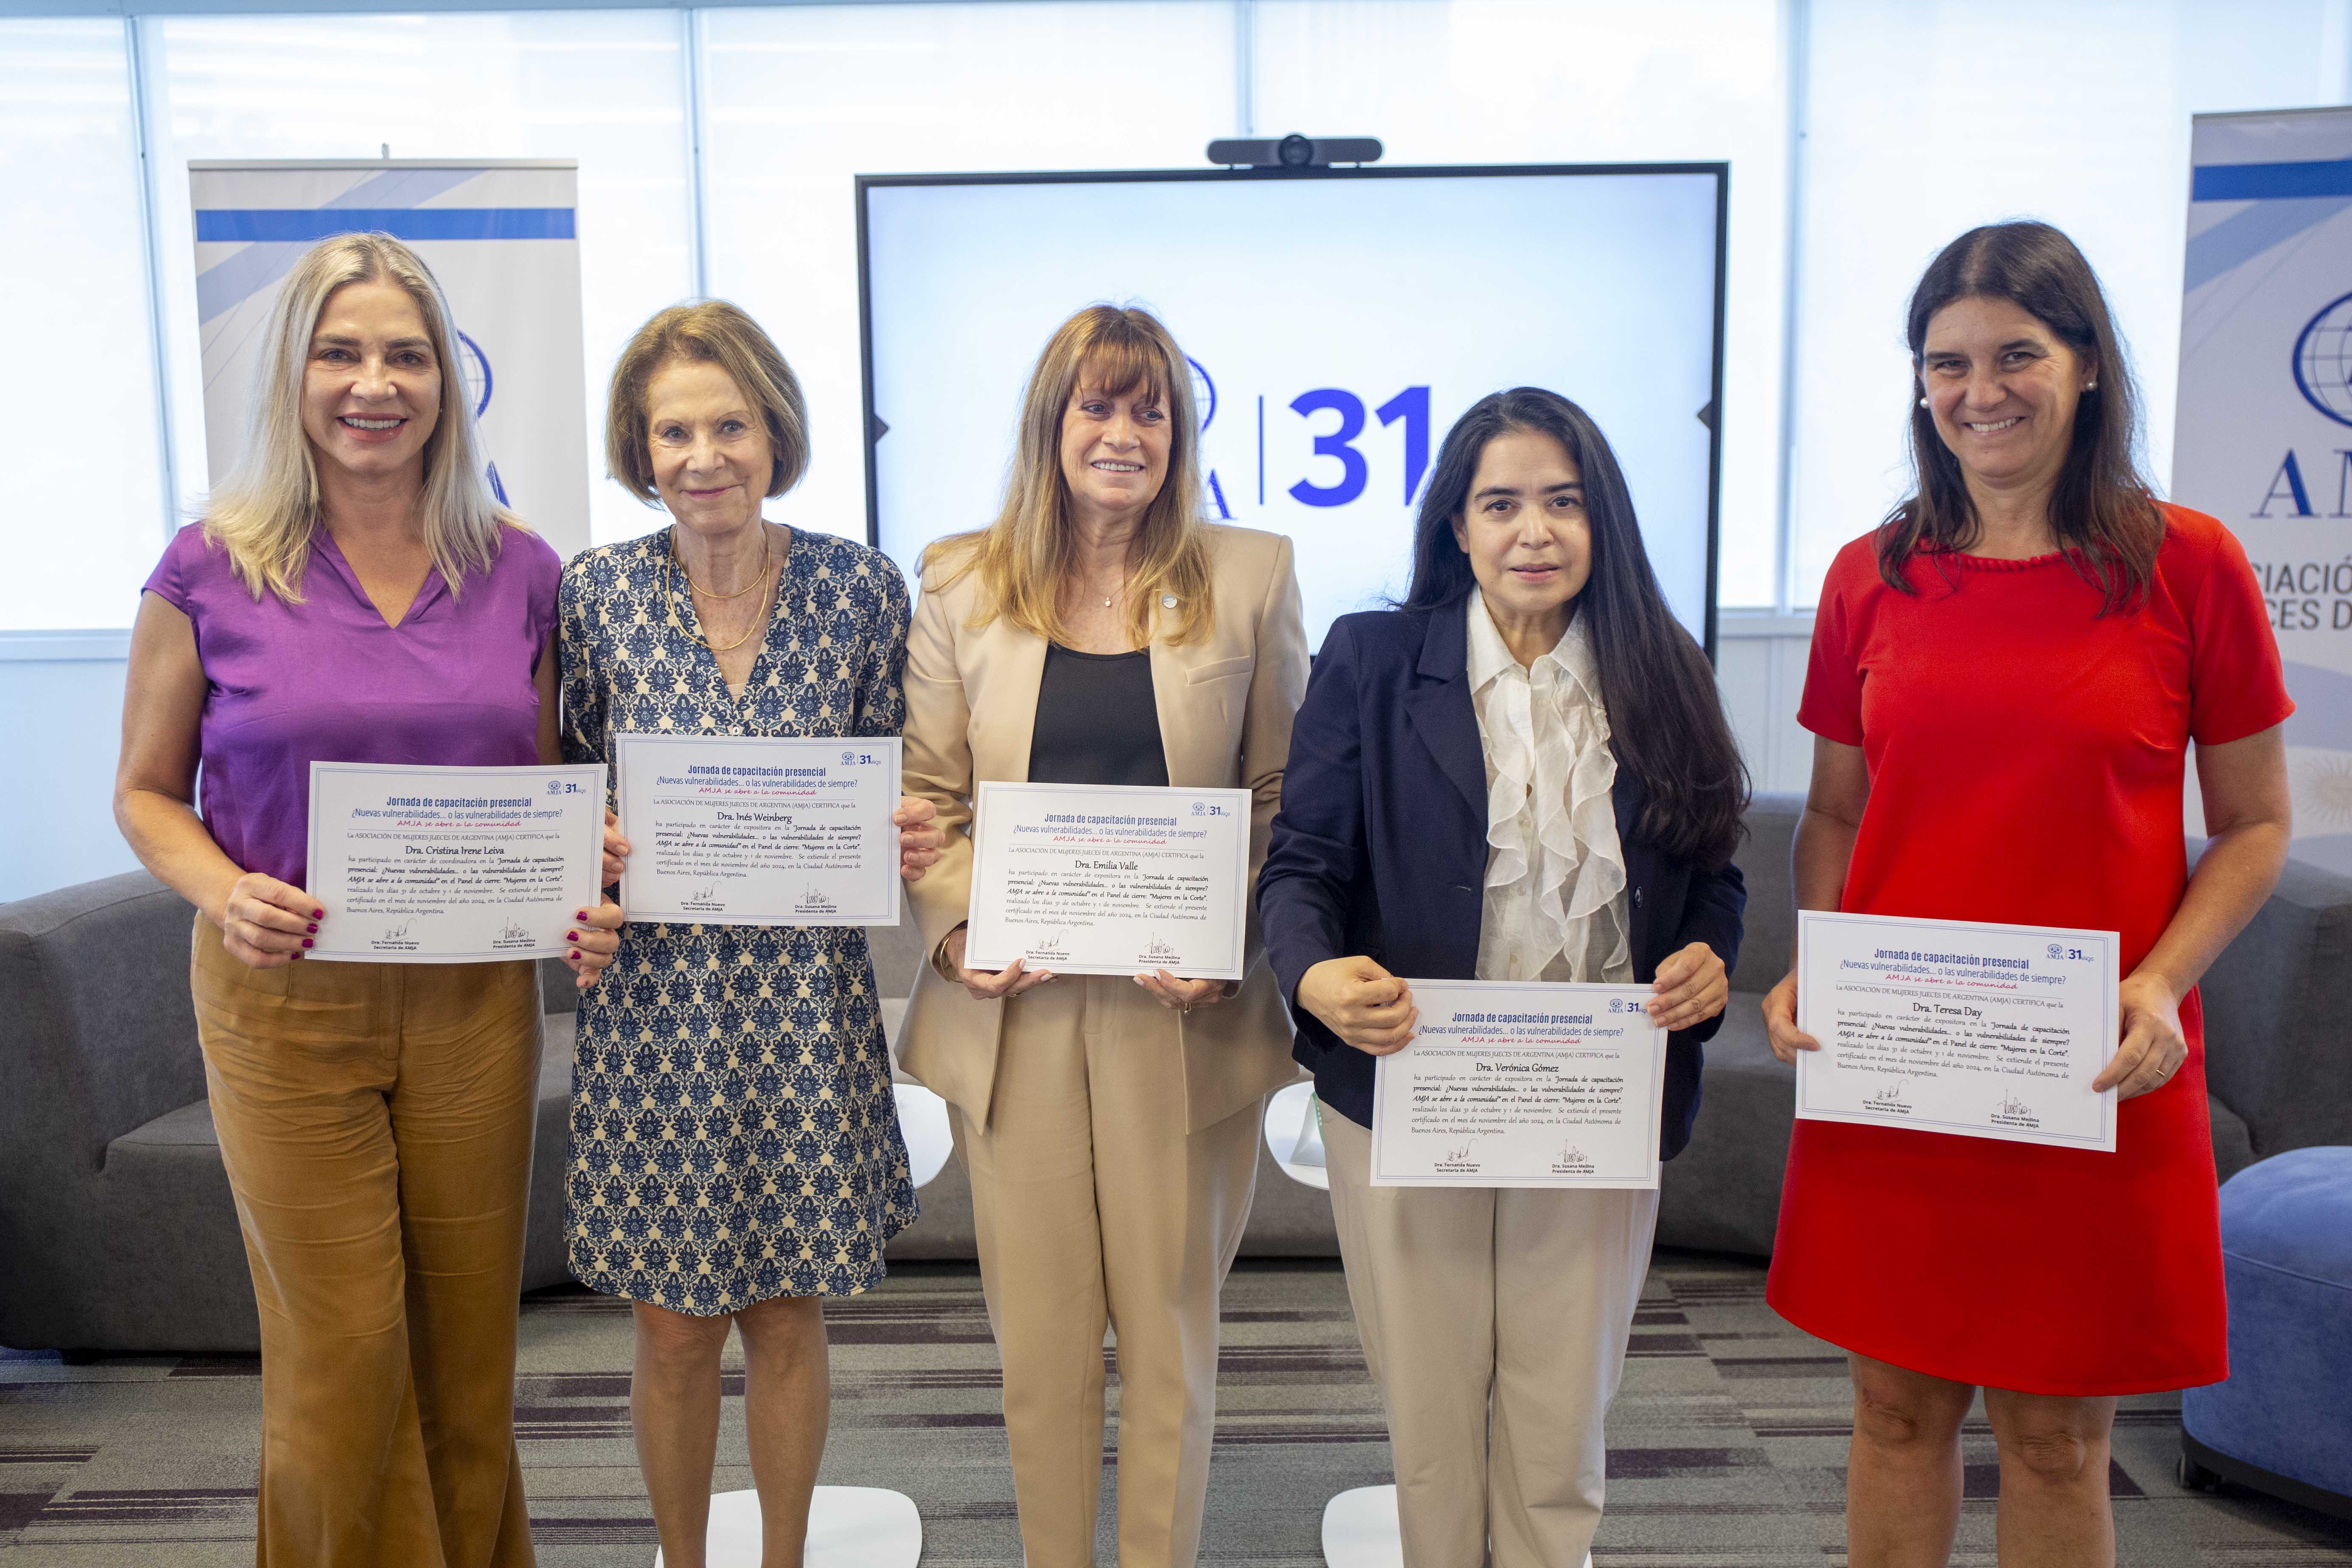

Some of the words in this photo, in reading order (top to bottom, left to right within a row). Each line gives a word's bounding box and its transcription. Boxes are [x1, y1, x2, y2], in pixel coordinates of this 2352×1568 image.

[1288, 386, 1430, 508] 31
[860, 755, 871, 764] 31
[688, 765, 720, 774] Jornada
[721, 766, 731, 775] de
[733, 766, 783, 777] capacitación
[785, 767, 826, 778] presencial
[565, 783, 577, 793] 31
[656, 776, 684, 785] ¿Nuevas
[684, 777, 744, 786] vulnerabilidades...
[752, 778, 761, 787] las
[762, 779, 816, 788] vulnerabilidades
[818, 779, 827, 788] de
[827, 779, 858, 789] siempre?
[387, 797, 421, 807] Jornada
[423, 797, 433, 807] de
[434, 797, 488, 809] capacitación
[490, 797, 532, 809] presencial
[351, 808, 381, 818] ¿Nuevas
[382, 809, 446, 819] vulnerabilidades...
[454, 810, 464, 819] las
[465, 810, 521, 819] vulnerabilidades
[523, 810, 532, 818] de
[533, 809, 563, 820] siempre?
[1210, 806, 1221, 815] 31
[717, 812, 734, 820] Dra.
[736, 812, 752, 821] Inés
[753, 812, 793, 824] Weinberg
[1044, 813, 1075, 823] Jornada
[1077, 814, 1086, 823] de
[1087, 815, 1136, 825] capacitación
[1137, 816, 1177, 826] presencial
[1013, 824, 1039, 834] ¿Nuevas
[1041, 825, 1097, 835] vulnerabilidades...
[1105, 827, 1114, 835] las
[1115, 827, 1167, 837] vulnerabilidades
[1168, 829, 1176, 837] de
[1178, 829, 1207, 839] siempre?
[405, 845, 424, 854] Dra.
[426, 846, 460, 855] Cristina
[461, 846, 482, 855] Irene
[484, 846, 505, 855] Leiva
[1075, 860, 1092, 869] Dra.
[1093, 860, 1118, 870] Emilia
[1119, 861, 1138, 870] Valle
[386, 906, 414, 915] República
[1874, 948, 1909, 960] Jornada
[1911, 951, 1922, 961] de
[1924, 953, 1980, 966] capacitación
[1982, 957, 2029, 969] presencial
[2068, 949, 2081, 960] 31
[1840, 959, 1869, 969] ¿Nuevas
[1870, 962, 1936, 974] vulnerabilidades...
[1945, 966, 1955, 976] las
[1956, 968, 2018, 981] vulnerabilidades
[2020, 972, 2030, 982] de
[2031, 974, 2066, 985] siempre?
[1967, 981, 2018, 990] comunidad
[1627, 1002, 1639, 1012] 31
[1913, 1002, 1932, 1013] Dra.
[1933, 1004, 1963, 1015] Teresa
[1964, 1007, 1983, 1019] Day
[1452, 1012, 1485, 1022] Jornada
[1486, 1013, 1496, 1023] de
[1498, 1013, 1549, 1024] capacitación
[1551, 1014, 1592, 1025] presencial
[1418, 1025, 1446, 1035] ¿Nuevas
[1448, 1025, 1508, 1035] vulnerabilidades...
[1516, 1026, 1526, 1035] las
[1527, 1026, 1582, 1036] vulnerabilidades
[1583, 1027, 1592, 1036] de
[1592, 1028, 1623, 1037] siempre?
[1976, 1031, 2026, 1042] vulnerabilidades
[1476, 1063, 1493, 1072] Dra.
[1495, 1063, 1530, 1072] Verónica
[1531, 1063, 1559, 1072] Gómez
